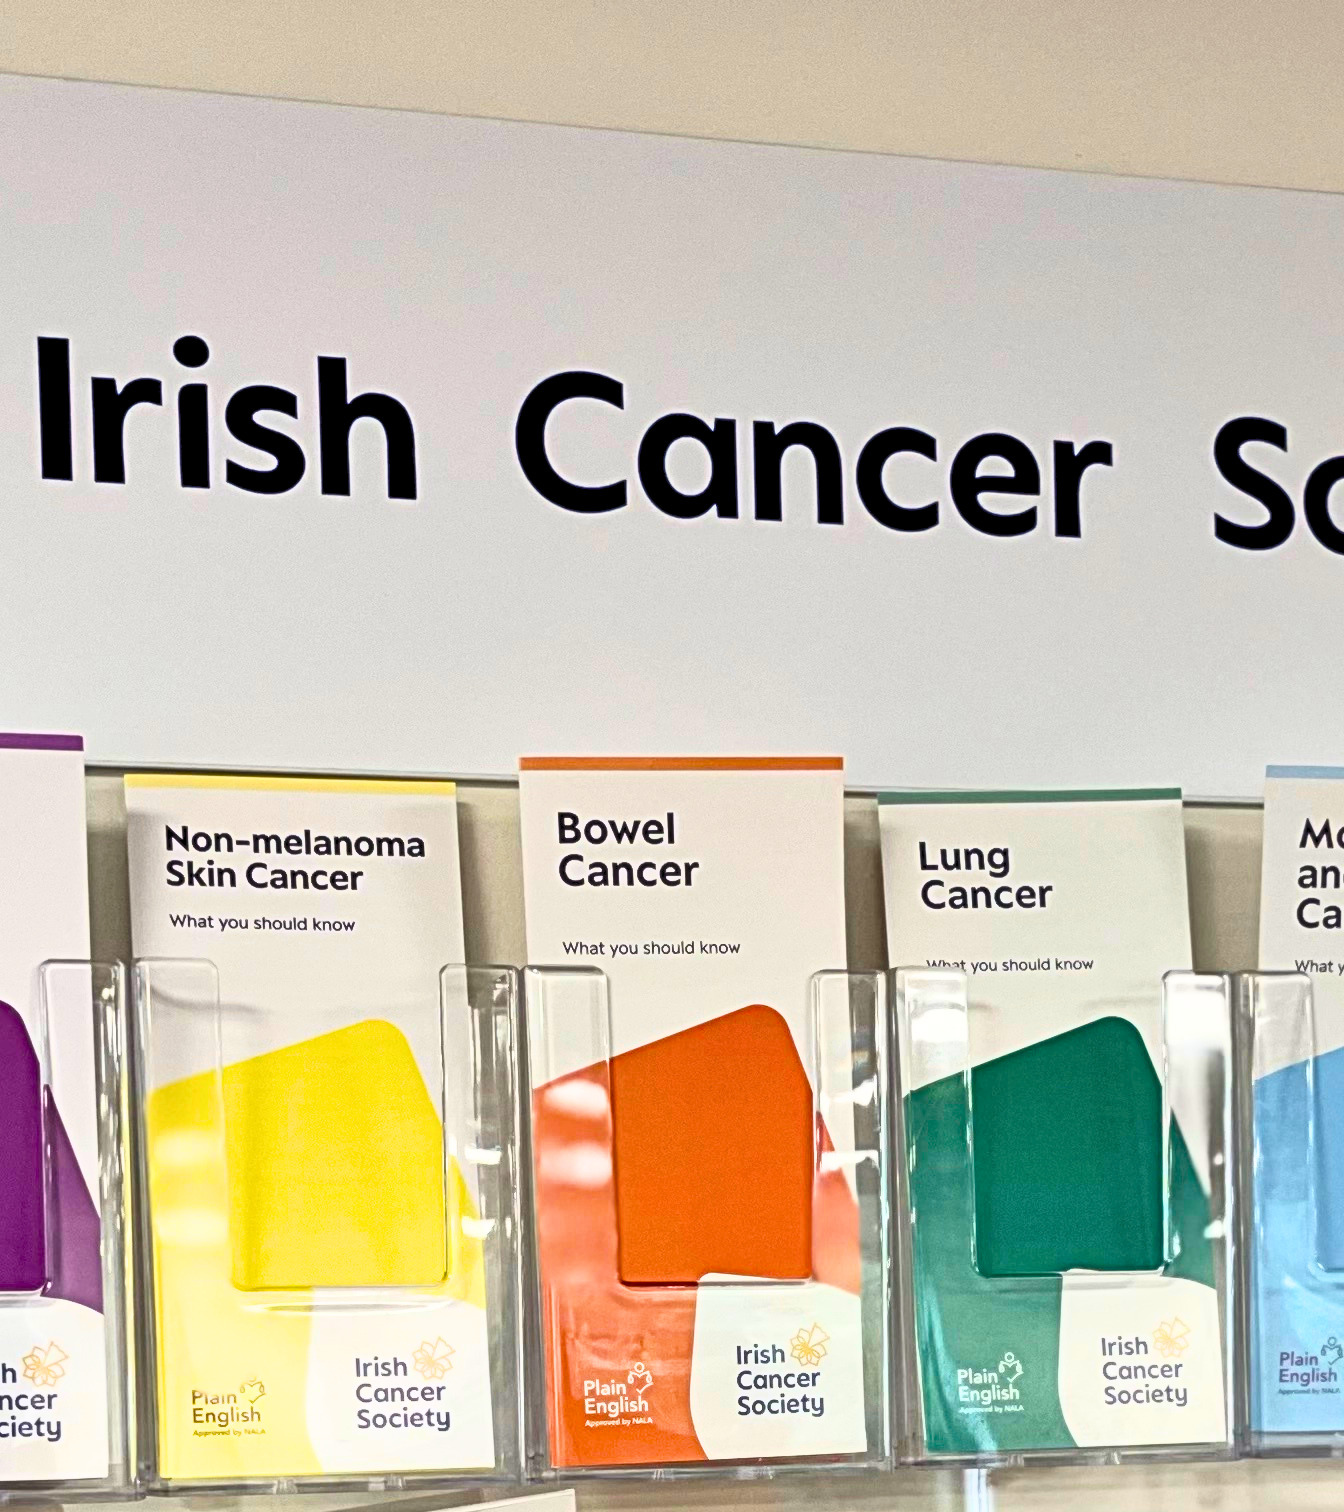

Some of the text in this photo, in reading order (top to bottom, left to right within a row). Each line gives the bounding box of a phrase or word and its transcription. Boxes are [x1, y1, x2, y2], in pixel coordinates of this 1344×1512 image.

[31, 334, 420, 503] Irish
[513, 368, 1114, 540] Cancer
[557, 811, 676, 846] Bowel
[165, 824, 425, 858] Non-melanoma
[919, 841, 1010, 877] Lung
[165, 860, 364, 891] Skin Cancer
[558, 854, 700, 889] Cancer
[920, 881, 1053, 909] Cancer
[563, 939, 740, 959] What you should know
[1295, 959, 1333, 974] What
[735, 1344, 785, 1365] Irish
[1101, 1336, 1148, 1357] Irish
[736, 1368, 821, 1389] Cancer
[1102, 1361, 1183, 1380] Cancer
[584, 1379, 627, 1396] Plain
[1103, 1384, 1188, 1407] Society
[584, 1395, 649, 1416] English
[737, 1392, 825, 1417] Society
[585, 1418, 620, 1428] Approved
